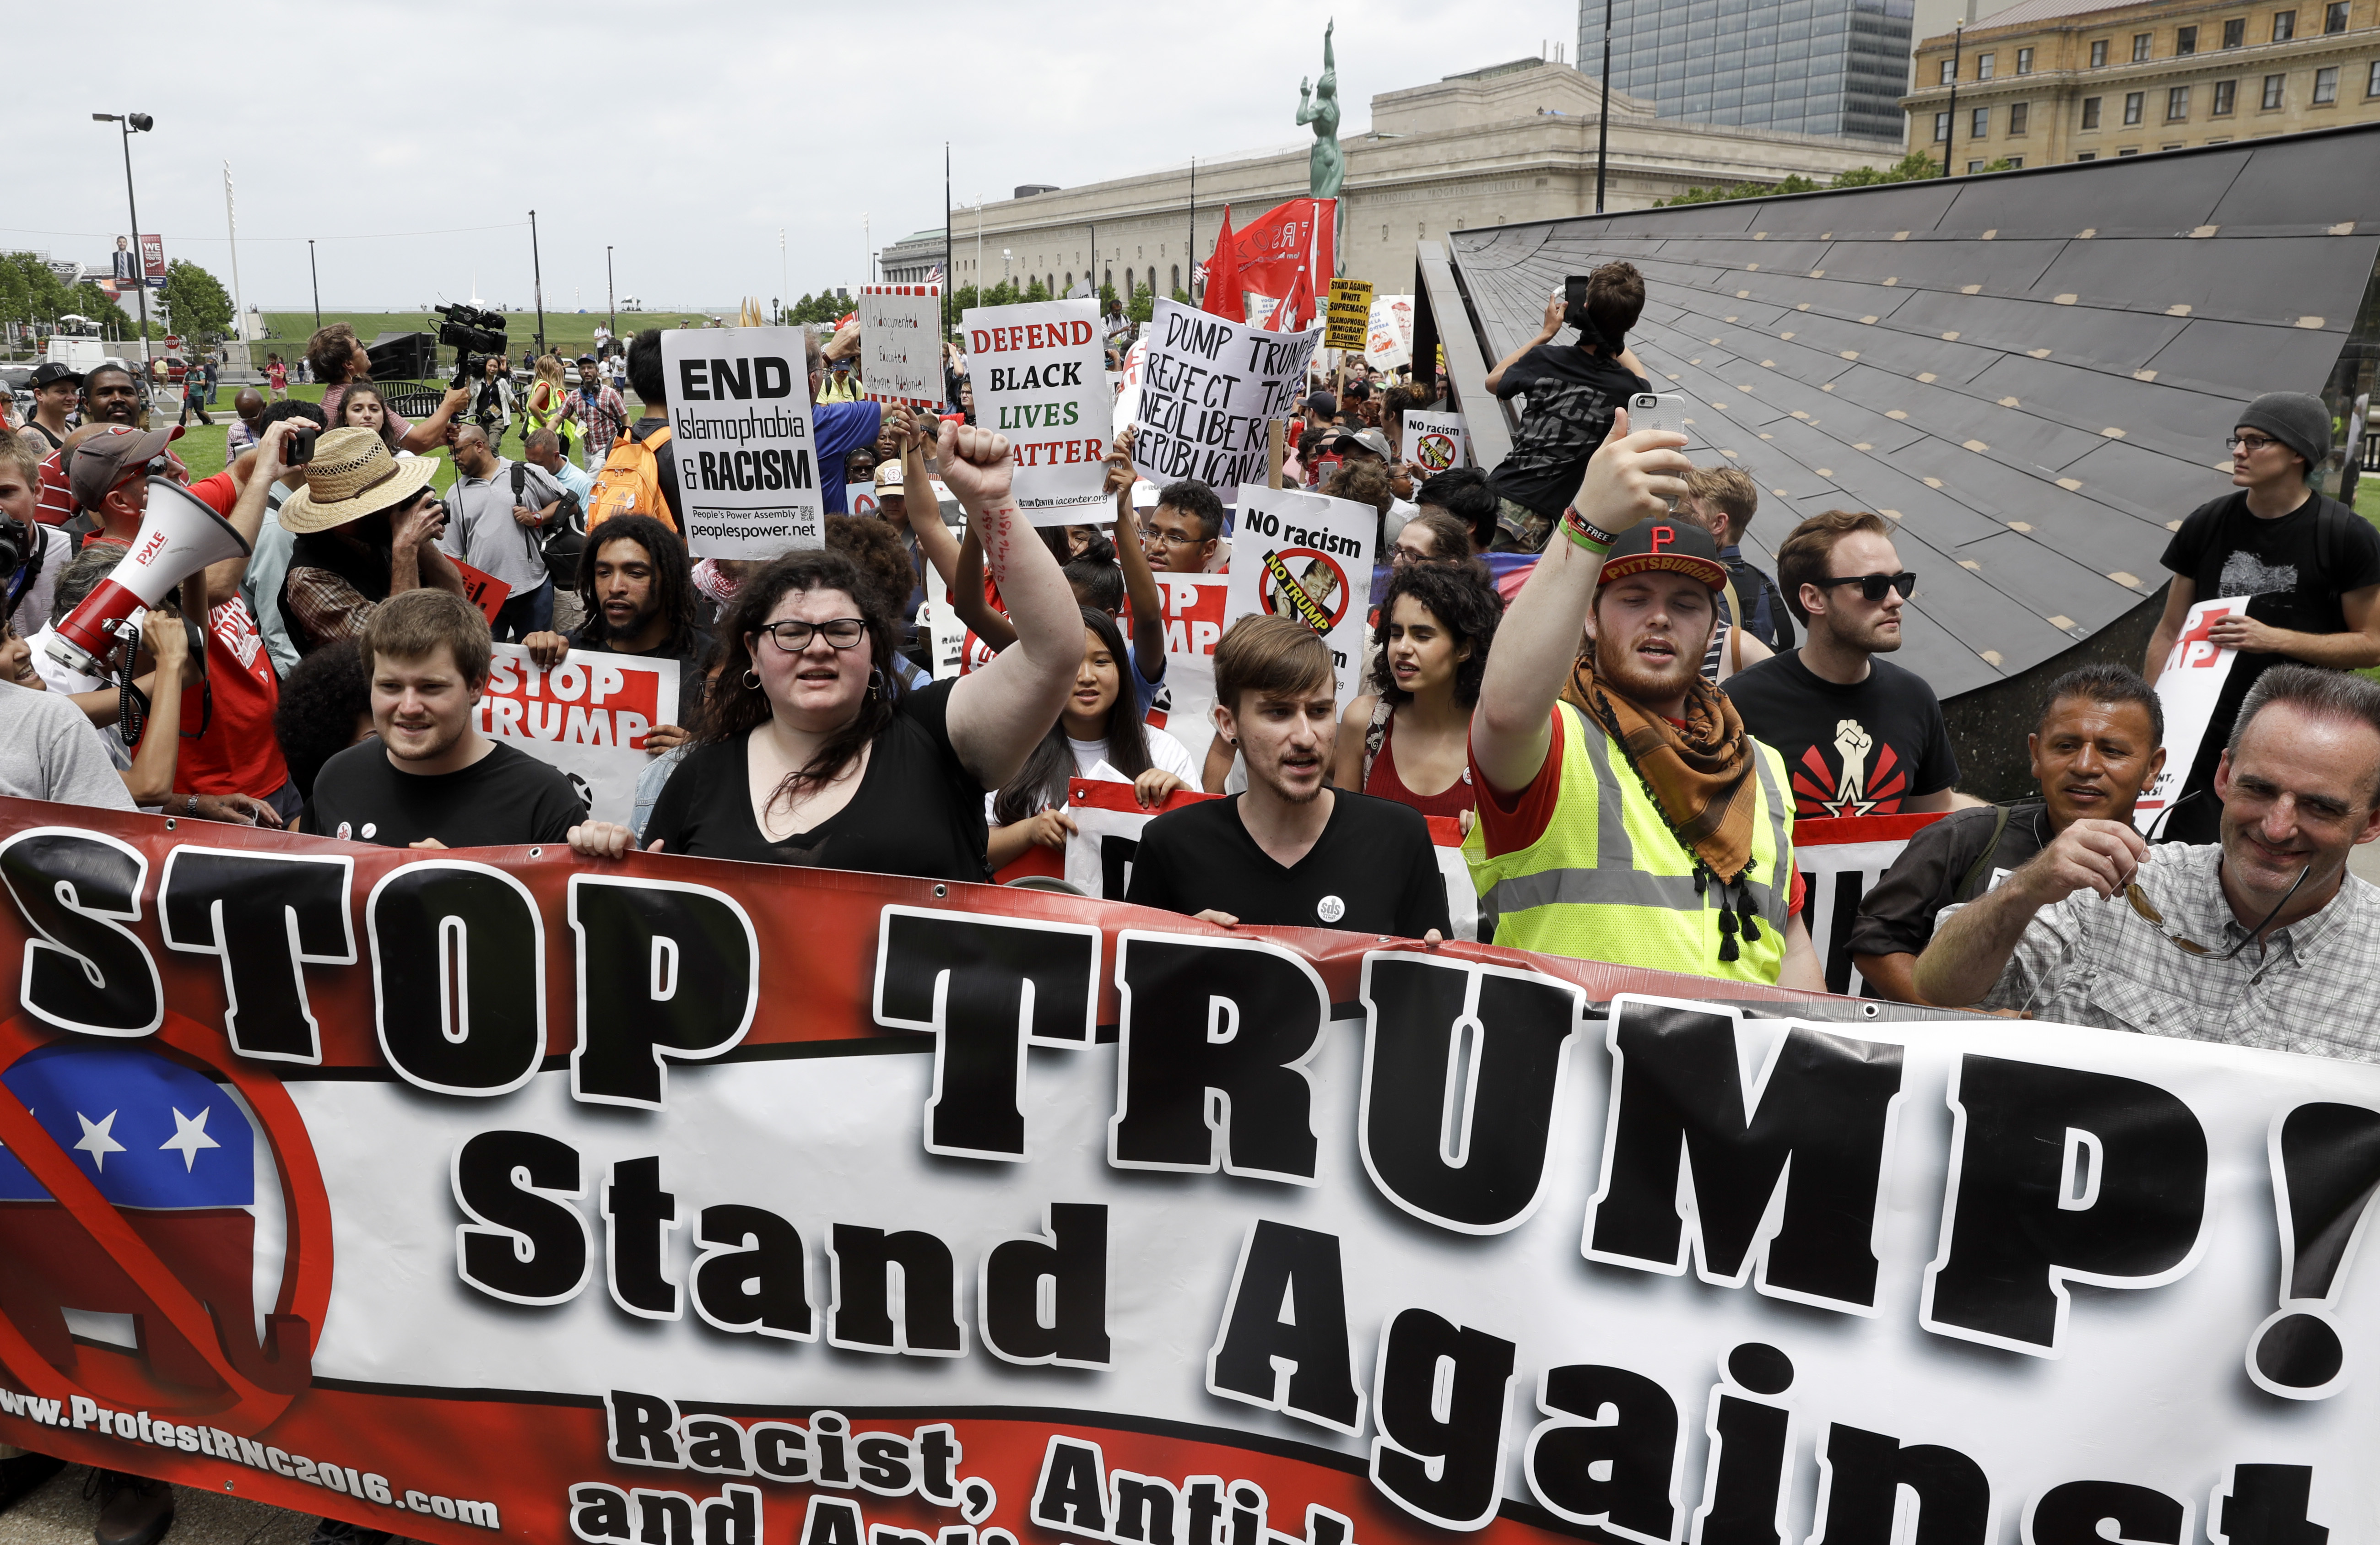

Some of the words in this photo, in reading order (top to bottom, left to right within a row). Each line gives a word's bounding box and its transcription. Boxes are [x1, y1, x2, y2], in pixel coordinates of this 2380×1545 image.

[1371, 191, 1416, 204] PATRIOTISM
[1427, 185, 1470, 198] PROGRESS
[1481, 180, 1522, 193] CULTURE
[143, 243, 161, 251] WE
[1331, 281, 1348, 290] STAND
[1349, 282, 1372, 293] AGAINST
[1341, 292, 1361, 302] WHITE
[864, 297, 919, 329] Undocumented
[1327, 316, 1367, 328] ISLAMOPHOBIA,
[1329, 302, 1368, 316] SUPREMACY,
[971, 320, 1093, 354] DEFEND
[1329, 324, 1364, 335] IMMIGRANT
[1331, 332, 1361, 342] BASHING!
[879, 345, 908, 364] Educated
[1165, 313, 1233, 361] DUMP
[1249, 336, 1309, 377] TRUMP
[679, 357, 791, 401] END
[865, 367, 891, 390] Siempre
[895, 374, 927, 393] Adelante!
[990, 361, 1083, 392] BLACK
[1146, 352, 1241, 409] REJECT
[1261, 375, 1299, 415] THE
[676, 405, 805, 446] Islamophobia
[999, 401, 1079, 430] LIVES
[1137, 388, 1280, 452] NEOLIBERA
[1408, 420, 1424, 431] NO
[1427, 424, 1460, 436] racism
[1012, 438, 1103, 467] ATTER
[1419, 437, 1429, 448] NO
[1428, 447, 1449, 468] TRUMP
[682, 458, 698, 490] &
[698, 449, 813, 492] RACISM
[726, 510, 751, 520] Power
[753, 509, 796, 520] Assembly
[1056, 494, 1108, 506] iacenter.org
[690, 522, 817, 541] peoplespower.net
[1245, 508, 1279, 537] NO
[1283, 524, 1361, 559] racism
[1586, 525, 1610, 541] FREE
[1650, 526, 1676, 553] P
[135, 531, 165, 565] PYLE
[146, 538, 169, 568] PyleAudio.com
[1606, 557, 1721, 583] PITTSBURGH
[1266, 554, 1287, 580] NO
[1284, 578, 1329, 630] TRUMP
[488, 654, 624, 705] STOP
[479, 696, 649, 747] TRUMP
[0, 825, 759, 1112] STOP
[872, 904, 2380, 1401] TRUMP!
[451, 1129, 1114, 1372] Stand
[604, 1389, 997, 1525] Racist,
